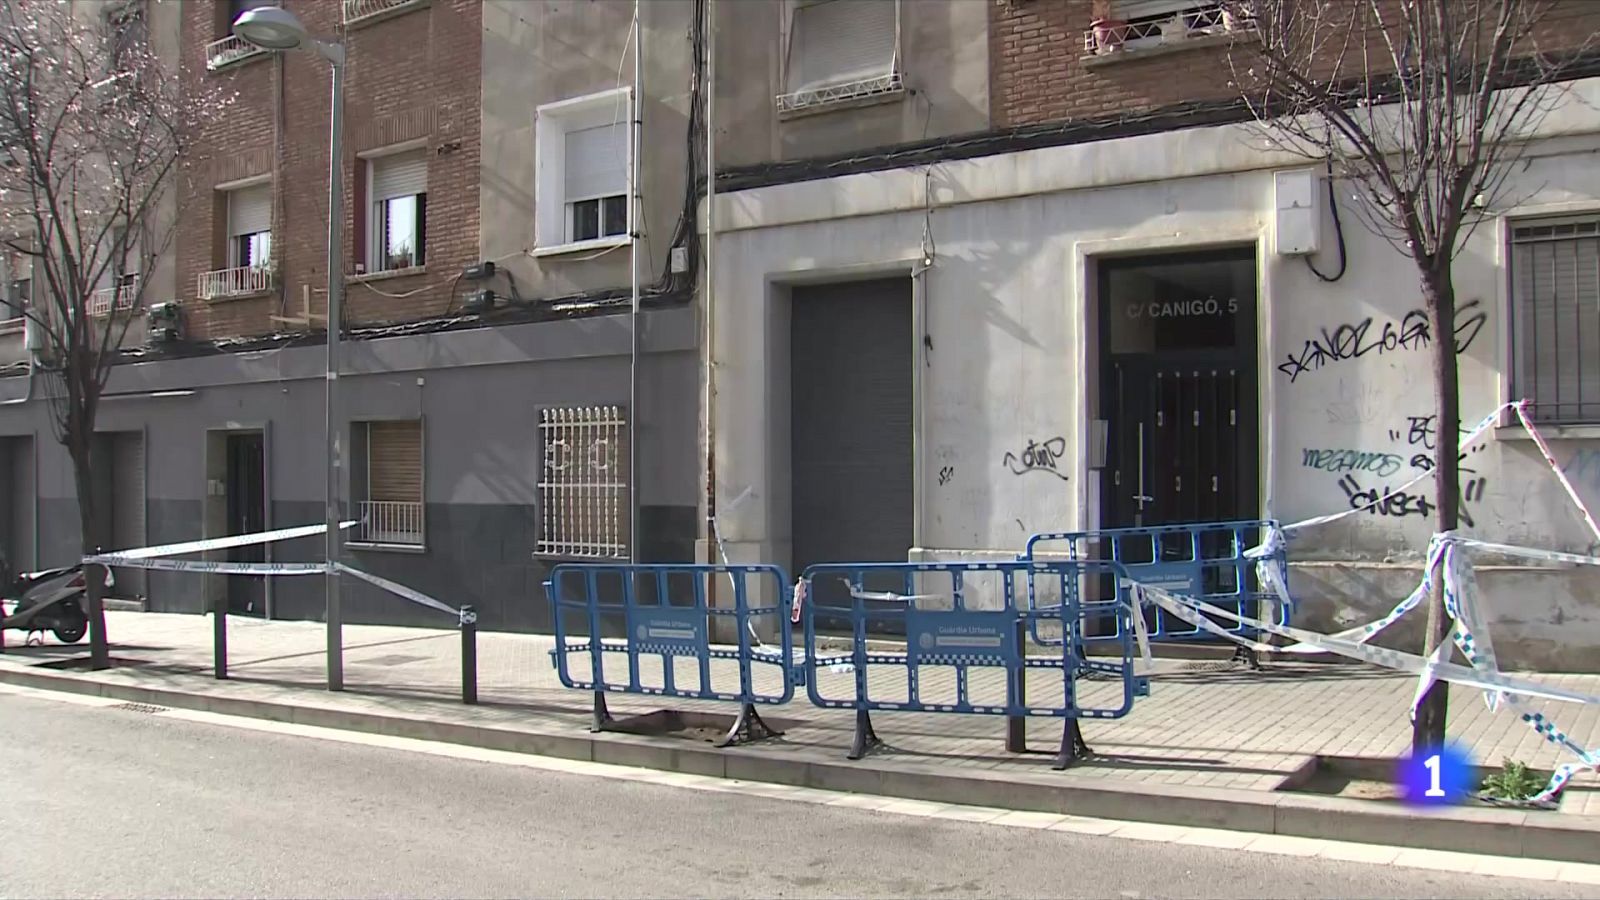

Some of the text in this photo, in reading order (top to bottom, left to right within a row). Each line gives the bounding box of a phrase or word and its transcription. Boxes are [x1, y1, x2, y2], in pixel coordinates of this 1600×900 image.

[1127, 296, 1238, 319] C/ CANIGÓ, 5
